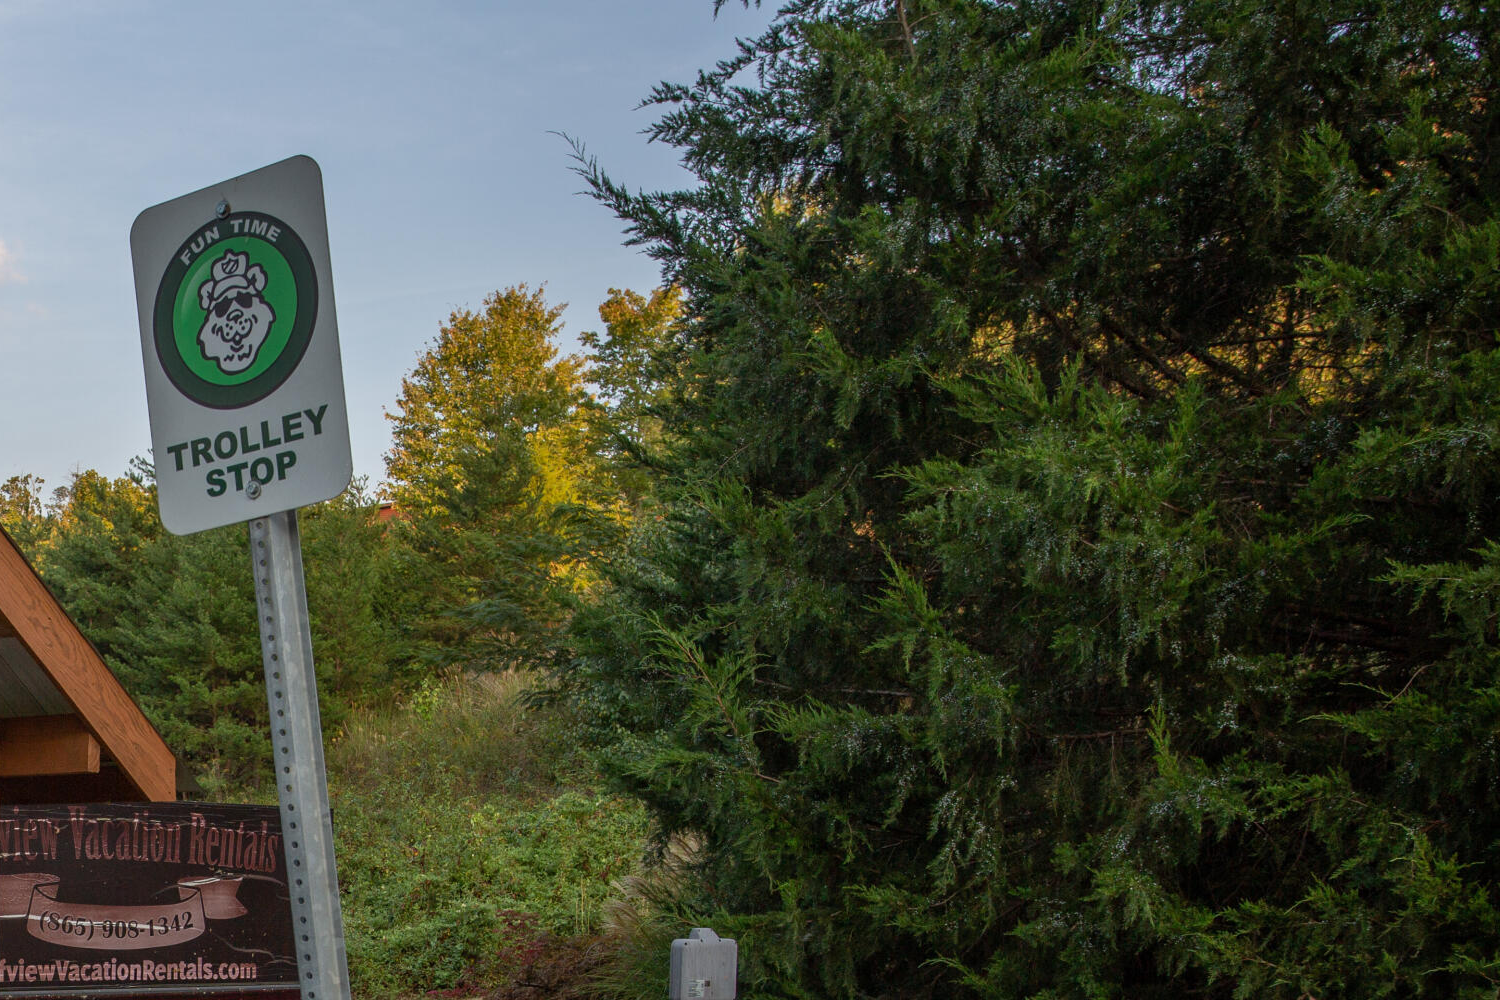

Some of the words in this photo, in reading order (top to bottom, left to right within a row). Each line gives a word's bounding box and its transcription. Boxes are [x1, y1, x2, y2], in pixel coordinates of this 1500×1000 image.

[180, 226, 221, 266] FUN
[230, 218, 282, 242] TIME
[167, 404, 328, 472] TROLLEY
[206, 450, 297, 497] STOP
[67, 805, 181, 863] Vacation
[187, 812, 278, 873] Rentals
[39, 910, 95, 941] (865)
[102, 911, 194, 939] 908-1342
